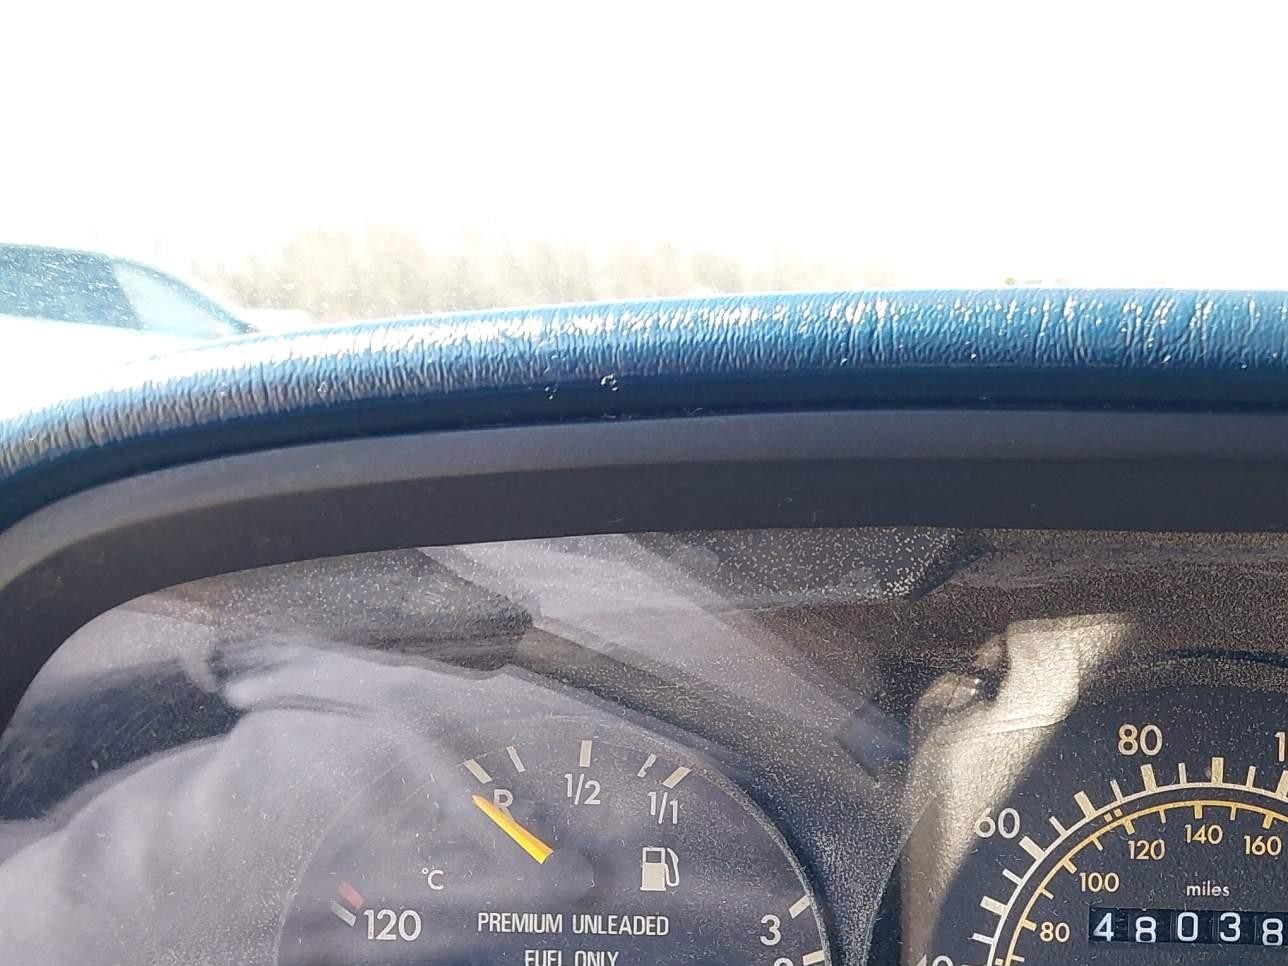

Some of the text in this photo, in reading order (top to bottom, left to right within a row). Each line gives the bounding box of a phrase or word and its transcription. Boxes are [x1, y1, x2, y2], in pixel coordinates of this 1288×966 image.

[1118, 725, 1162, 756] 80
[564, 773, 600, 805] 1/2
[648, 792, 678, 824] 1/1
[975, 808, 1020, 840] 60
[1184, 825, 1223, 845] 140
[1128, 840, 1166, 861] 120
[1244, 835, 1282, 856] 160
[1079, 872, 1119, 893] 100
[1186, 881, 1230, 897] miles
[363, 909, 421, 941] 120
[477, 912, 669, 937] PREMIUM UNLEADED
[760, 915, 782, 945] 3
[1040, 922, 1070, 943] 80
